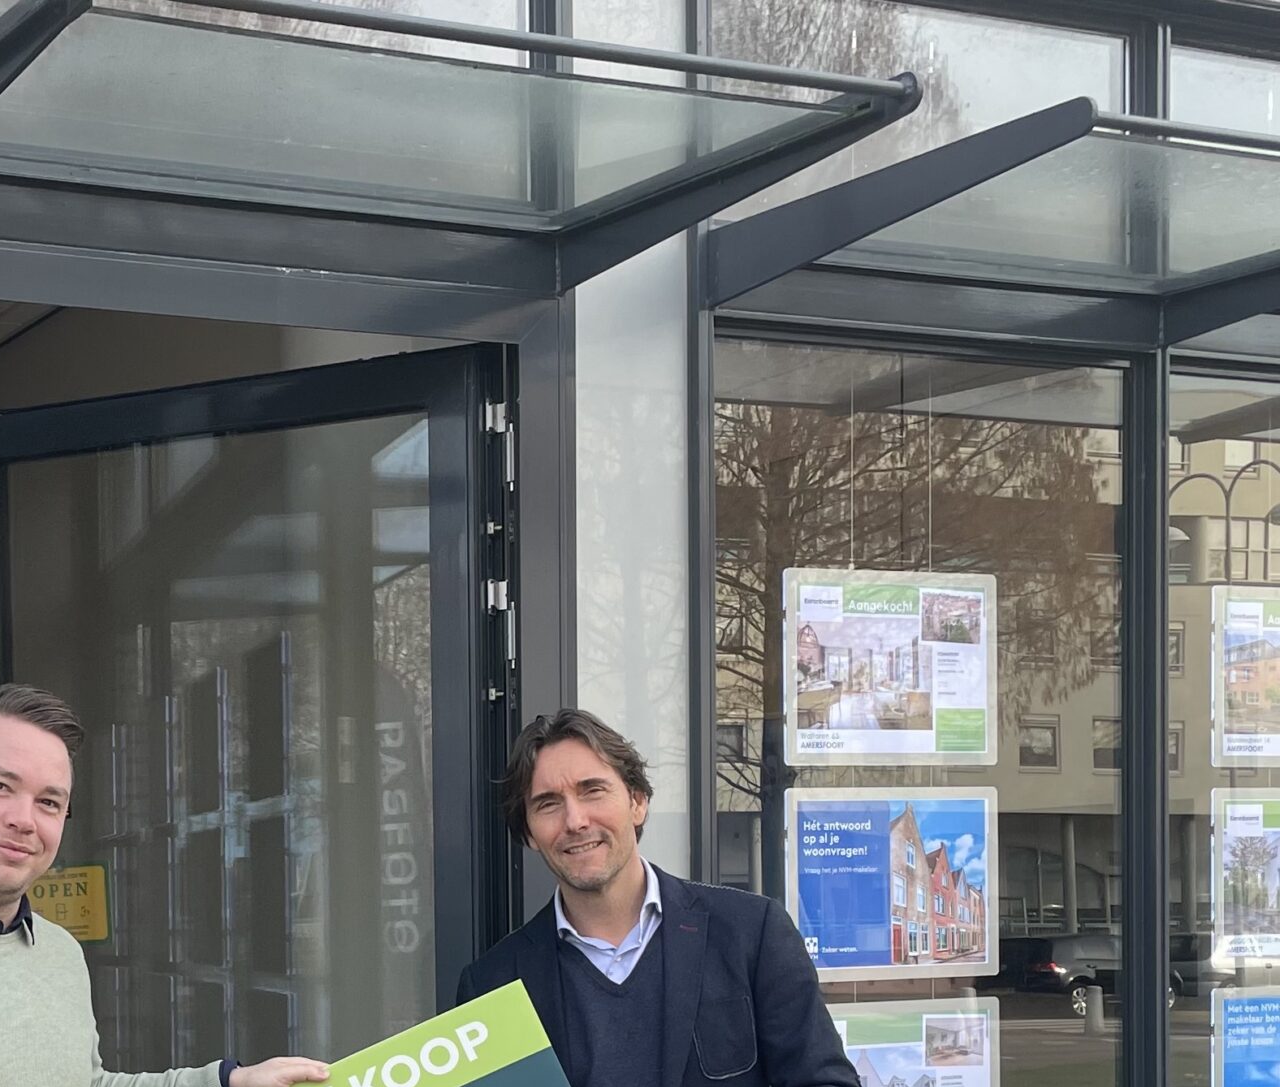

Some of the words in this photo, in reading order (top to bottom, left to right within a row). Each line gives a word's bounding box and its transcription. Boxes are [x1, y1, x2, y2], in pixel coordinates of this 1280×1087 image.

[848, 599, 913, 613] Aangekocht
[803, 819, 822, 831] Hét
[823, 819, 872, 831] antwoord
[803, 834, 817, 846] op
[818, 832, 828, 844] al
[829, 832, 840, 846] je
[802, 845, 868, 858] woonvragen!
[32, 881, 89, 899] OPEN
[1227, 1004, 1243, 1013] Met
[1244, 1005, 1260, 1013] een
